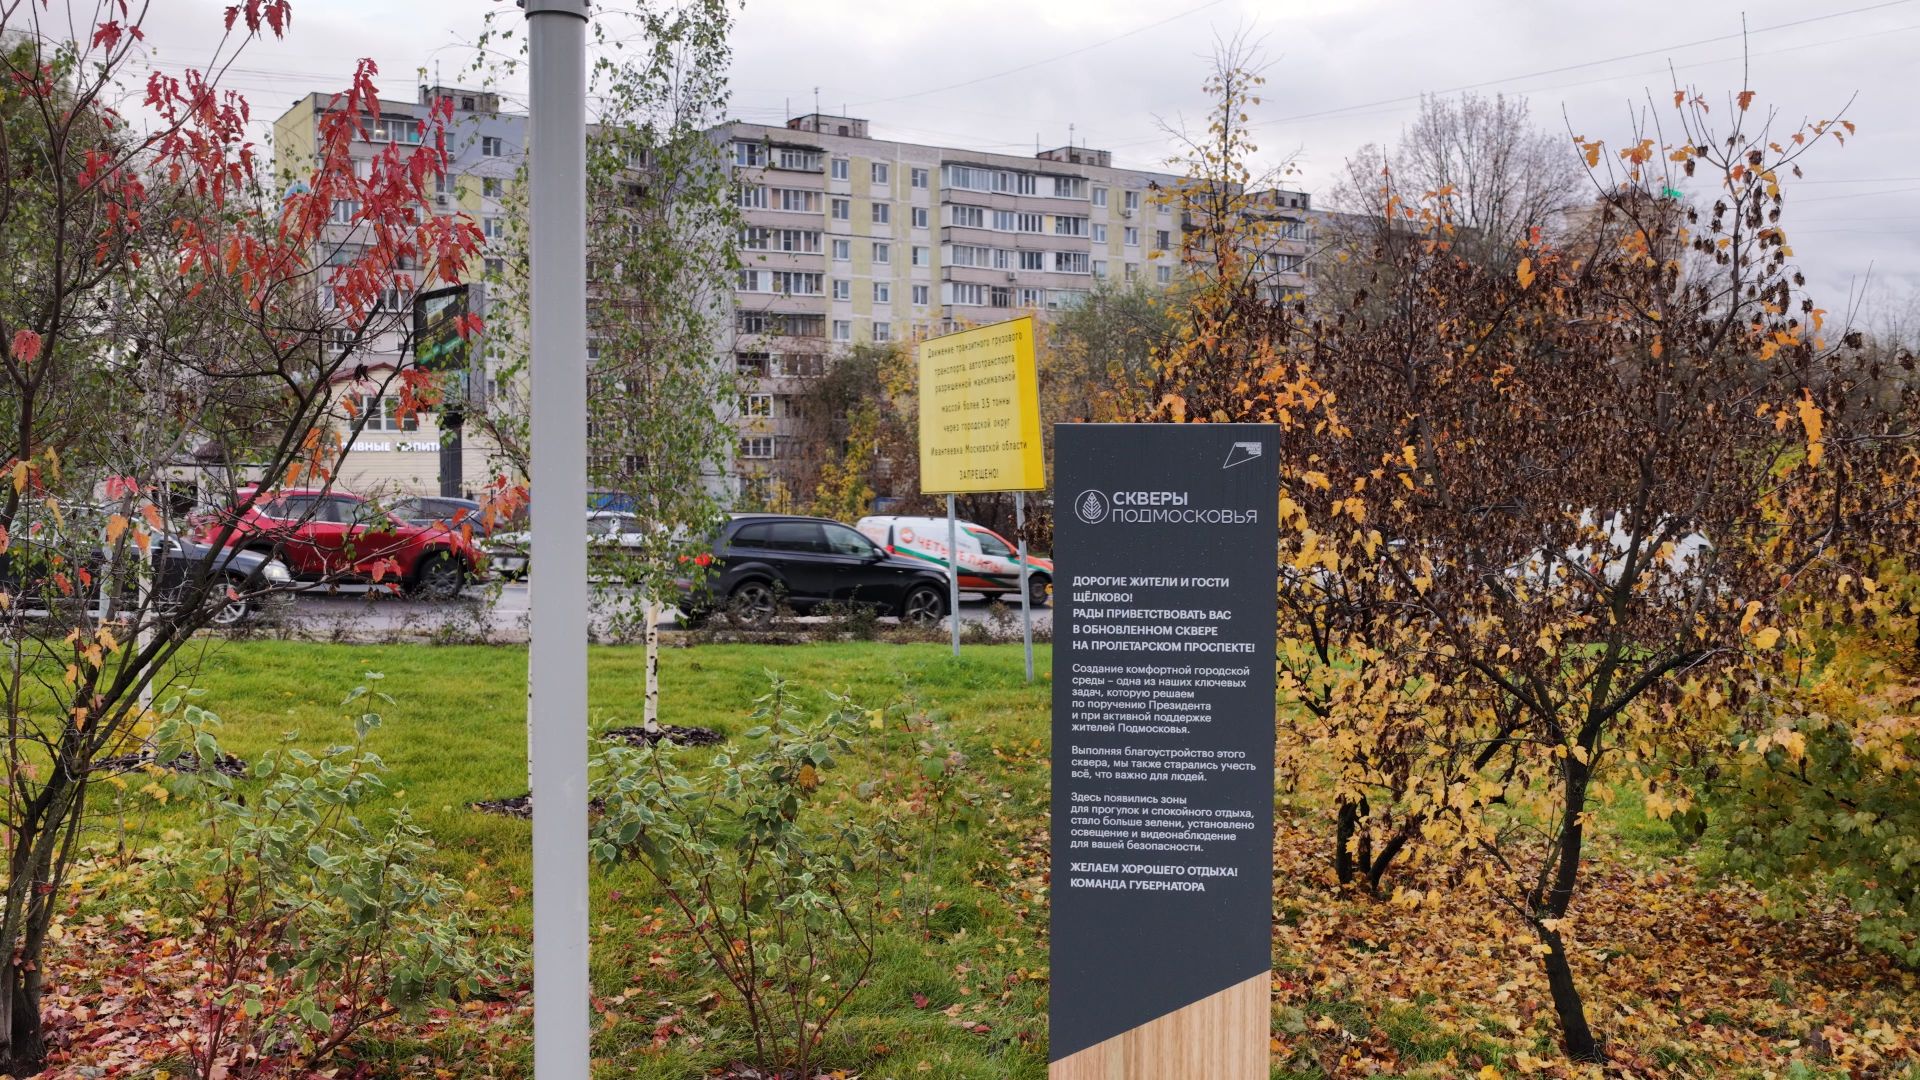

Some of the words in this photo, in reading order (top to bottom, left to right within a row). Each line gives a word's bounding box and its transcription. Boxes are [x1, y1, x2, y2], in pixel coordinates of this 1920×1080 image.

[992, 332, 1022, 346] грузового
[941, 402, 960, 412] массой
[963, 400, 980, 410] более
[992, 398, 1010, 407] тонны
[944, 424, 959, 433] через
[961, 418, 990, 431] городской
[994, 418, 1010, 429] округ
[931, 446, 963, 457] Ивантеевка
[965, 441, 1000, 454] Московской
[1002, 440, 1028, 451] области
[959, 468, 999, 480] ЗАПРЕЩЕНО!
[1113, 492, 1188, 506] СКВЕРЫ
[1112, 509, 1257, 523] ПОДМОСКОВЬЯ
[919, 538, 965, 561] ЧЕТЫЕ
[1073, 575, 1127, 587] ДОРОГИЕ
[1129, 576, 1178, 587] ЖИТЕЛИ
[1180, 577, 1188, 587] И
[1192, 577, 1229, 587] ГОСТИ
[1073, 590, 1132, 603] ЩЁЛКОВО!
[1073, 608, 1103, 619] РАДЫ
[1106, 609, 1206, 619] ПРИВЕТСТВОВАТЬ
[1209, 609, 1231, 619] ВАС
[1073, 624, 1079, 634] В
[1082, 624, 1172, 635] ОБНОВЛЕННОМ
[1175, 626, 1217, 636] СКВЕРЕ
[1073, 640, 1088, 650] НА
[1091, 640, 1181, 651] ПРОЛЕТАРСКОМ
[1184, 642, 1255, 652] ПРОСПЕКТЕ!
[1072, 663, 1123, 675] Создание
[1126, 665, 1192, 677] комфортной
[1194, 665, 1250, 677] городской
[1072, 677, 1105, 687] среды
[1116, 677, 1141, 686] одна
[1194, 679, 1246, 687] ключевых
[1072, 688, 1104, 698] задач,
[1106, 689, 1150, 699] которую
[1153, 690, 1194, 699] решаем
[1087, 701, 1146, 710] поручению
[1148, 700, 1211, 711] Президента
[1081, 712, 1100, 722] при
[1103, 711, 1151, 721] активной
[1154, 714, 1212, 724] поддержке
[1072, 722, 1115, 732] жителей
[1118, 723, 1190, 734] Подмосковья.
[1072, 745, 1121, 756] Выполняя
[1124, 746, 1214, 758] благоустройство
[1216, 750, 1245, 758] этого
[1072, 759, 1110, 768] сквера,
[1164, 761, 1218, 770] старались
[1221, 763, 1256, 771] учесть
[1072, 769, 1092, 779] всё,
[1149, 773, 1168, 781] для
[1171, 772, 1207, 782] людей.
[1071, 792, 1101, 802] Здесь
[1104, 794, 1158, 803] появились
[1160, 796, 1187, 804] зоны
[1071, 806, 1088, 814] для
[1091, 807, 1139, 816] прогулок
[1151, 807, 1212, 818] спокойного
[1215, 809, 1254, 819] отдыха,
[1071, 817, 1100, 825] стало
[1103, 817, 1142, 826] больше
[1145, 819, 1184, 828] зелени,
[1187, 820, 1255, 829] установлено
[1071, 829, 1129, 838] освещение
[1140, 829, 1236, 841] видеонаблюдение
[1070, 840, 1088, 848] для
[1091, 839, 1125, 849] вашей
[1127, 840, 1204, 851] безопасности.
[1070, 862, 1118, 873] ЖЕЛАЕМ
[1121, 863, 1185, 875] ХОРОШЕГО
[1187, 865, 1238, 877] ОТДЫХА!
[1070, 878, 1126, 889] КОМАНДА
[1129, 879, 1205, 891] ГУБЕРНАТОРА
